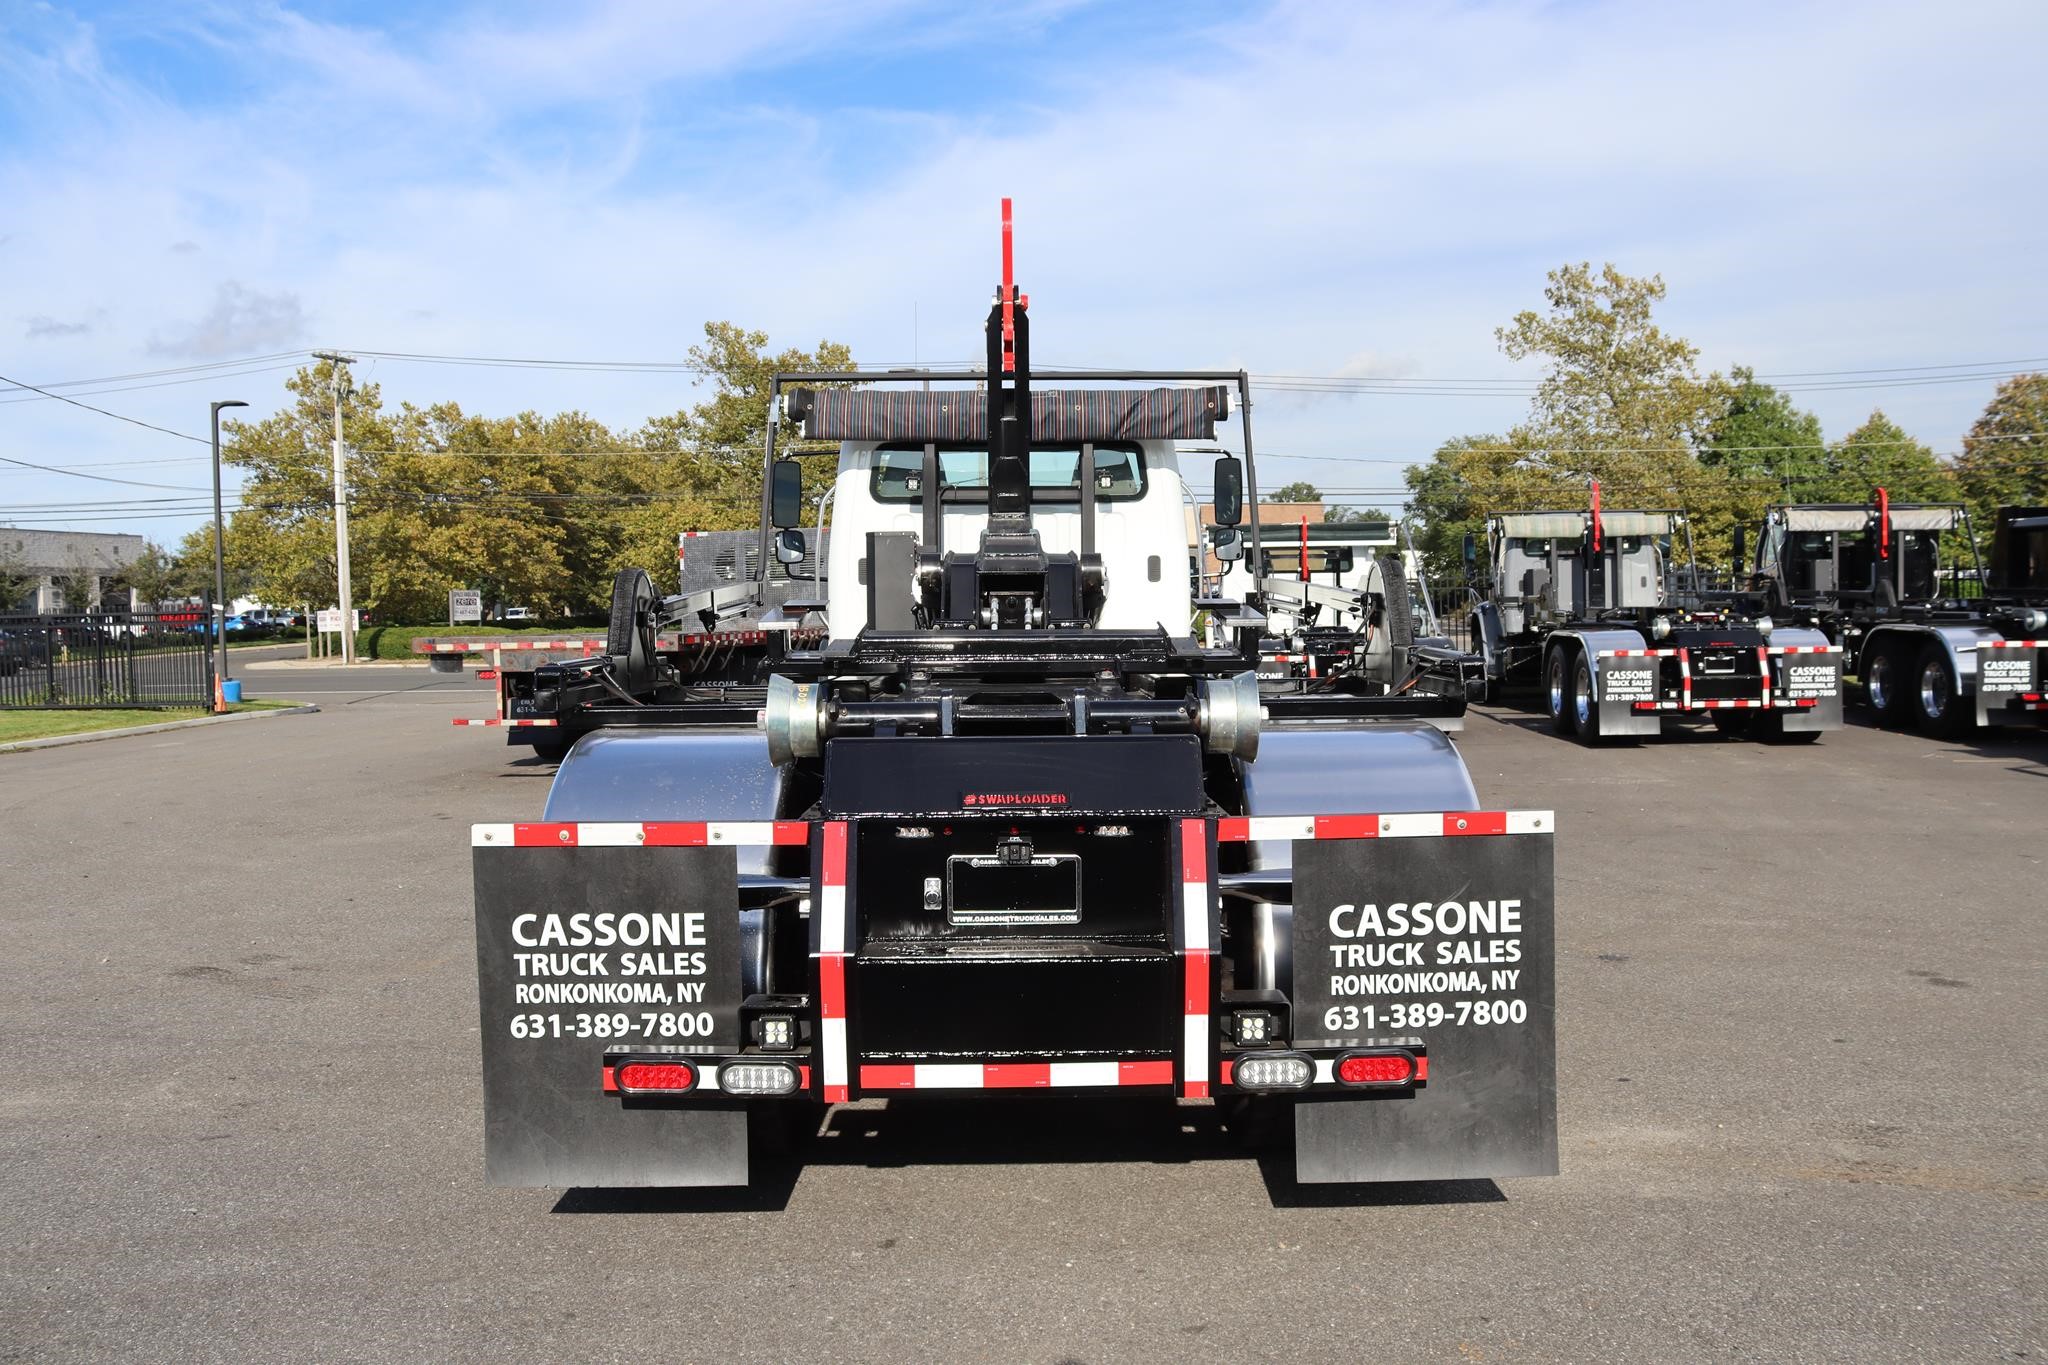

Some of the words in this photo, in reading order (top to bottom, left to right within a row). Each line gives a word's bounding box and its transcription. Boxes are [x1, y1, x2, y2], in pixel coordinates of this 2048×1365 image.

[1606, 670, 1652, 680] CASSONE
[1790, 666, 1836, 675] CASSONE
[1984, 661, 2031, 670] CASSONE
[978, 794, 1067, 804] SWAPLOADER
[511, 912, 706, 947] CASSONE
[952, 914, 1078, 923] WWW.CASSONETRUCKSALES.COM
[1328, 899, 1522, 938] CASSONE
[513, 952, 609, 977] TRUCK
[620, 952, 707, 976] SALES
[1330, 942, 1424, 968] TRUCK
[1436, 939, 1522, 965] SALES
[515, 982, 673, 1006] RONKONKOMA,
[676, 982, 706, 1004] NY
[1330, 970, 1488, 996] RONKONKOMA,
[1491, 969, 1521, 991] NY
[510, 1012, 714, 1039] 631-389-7800
[1323, 999, 1528, 1031] 631-389-7800
